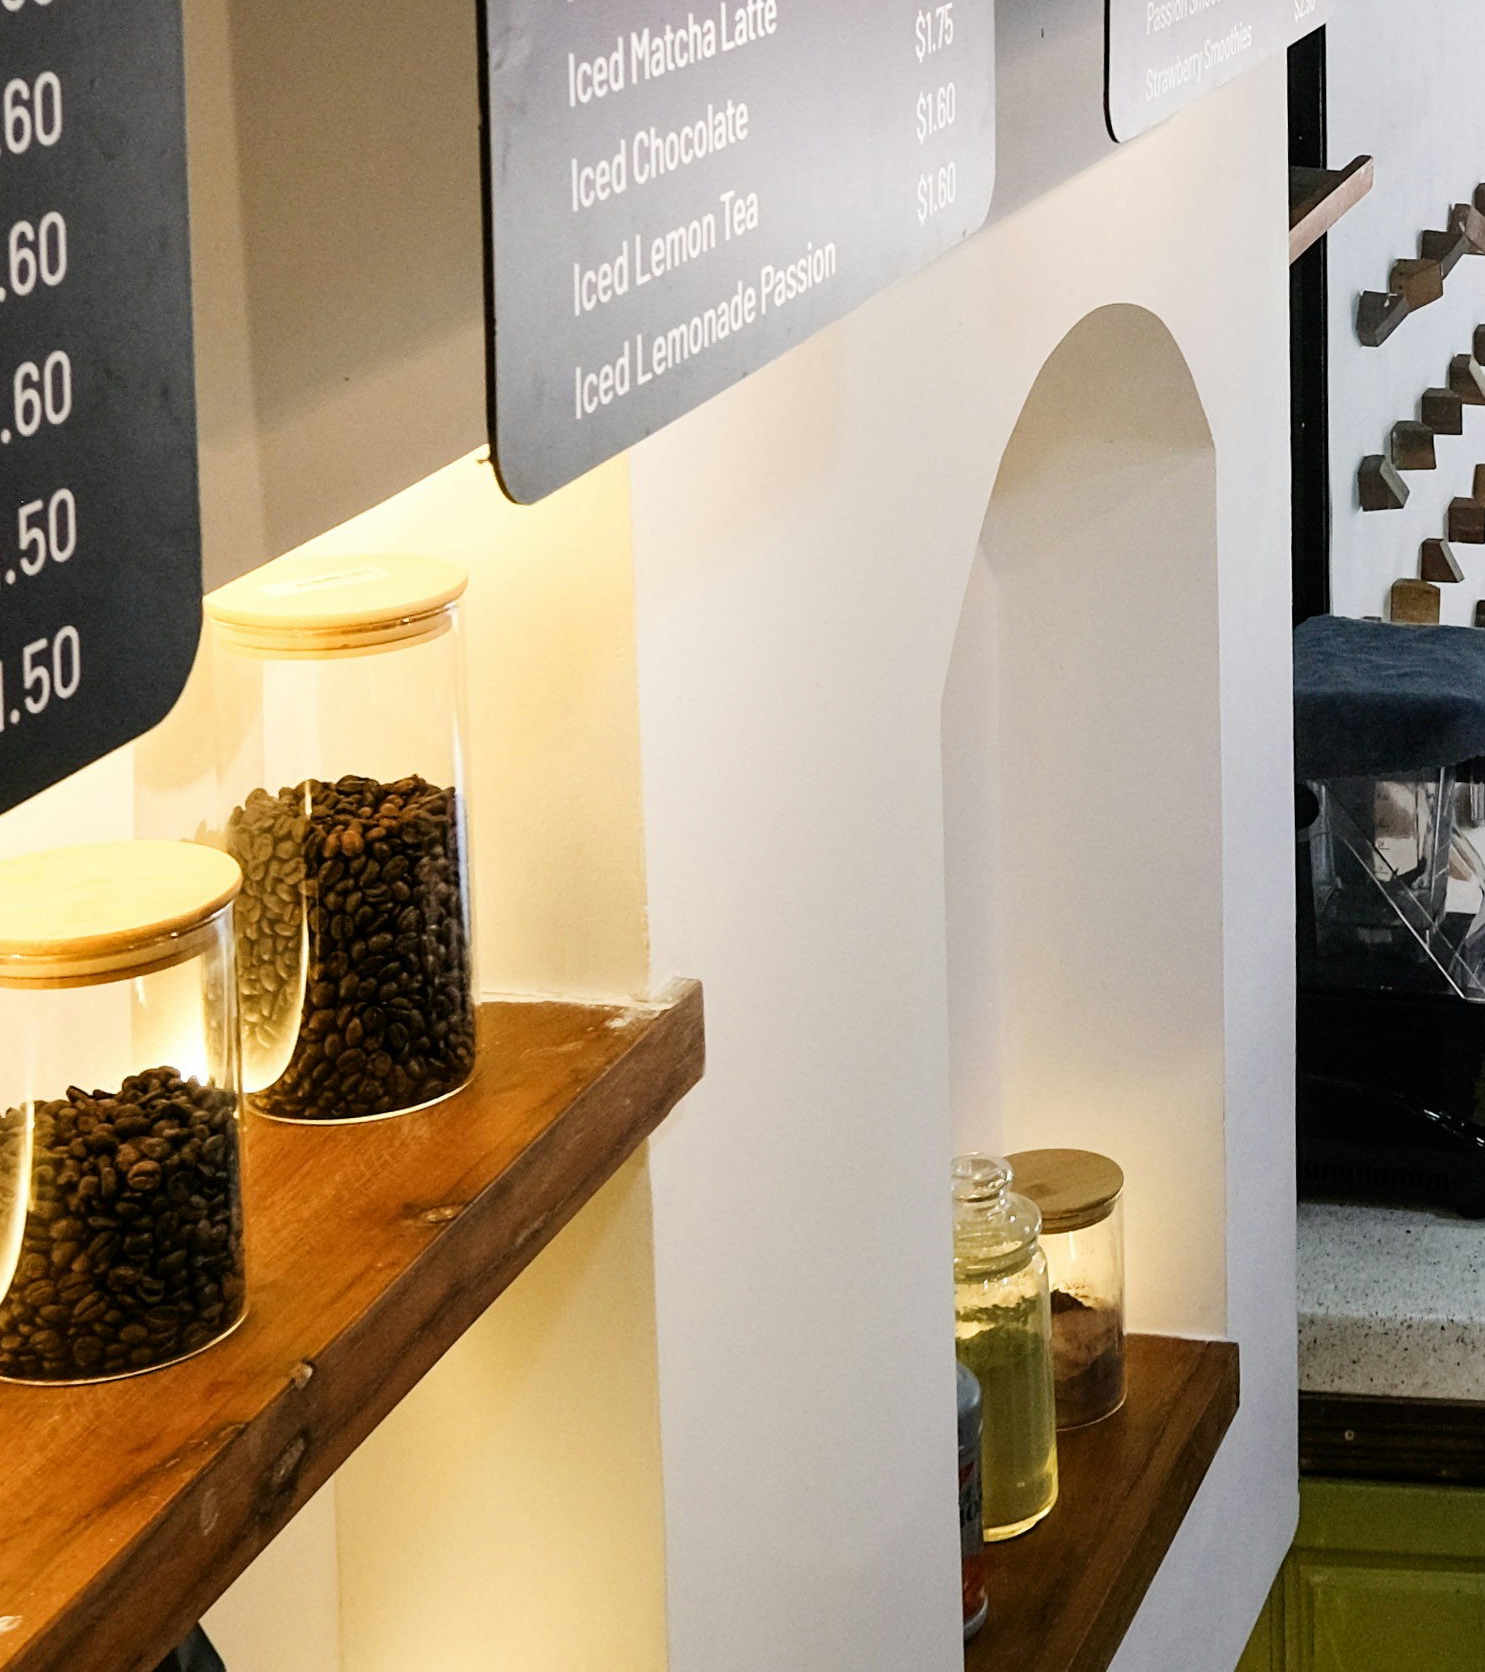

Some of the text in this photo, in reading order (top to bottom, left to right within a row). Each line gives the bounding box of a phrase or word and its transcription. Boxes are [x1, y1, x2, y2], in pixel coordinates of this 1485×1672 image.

[568, 37, 624, 107] Iced
[631, 13, 716, 84] Matcha
[916, 2, 953, 62] $1.75
[1146, 22, 1252, 101] Strawberry Smoothies
[571, 100, 748, 212] Iced Chocolate
[917, 83, 955, 144] $1.60
[917, 162, 955, 225] $1.60
[574, 190, 758, 316] Iced Lemon Tea
[575, 241, 835, 420] Iced Lemonade Passion
